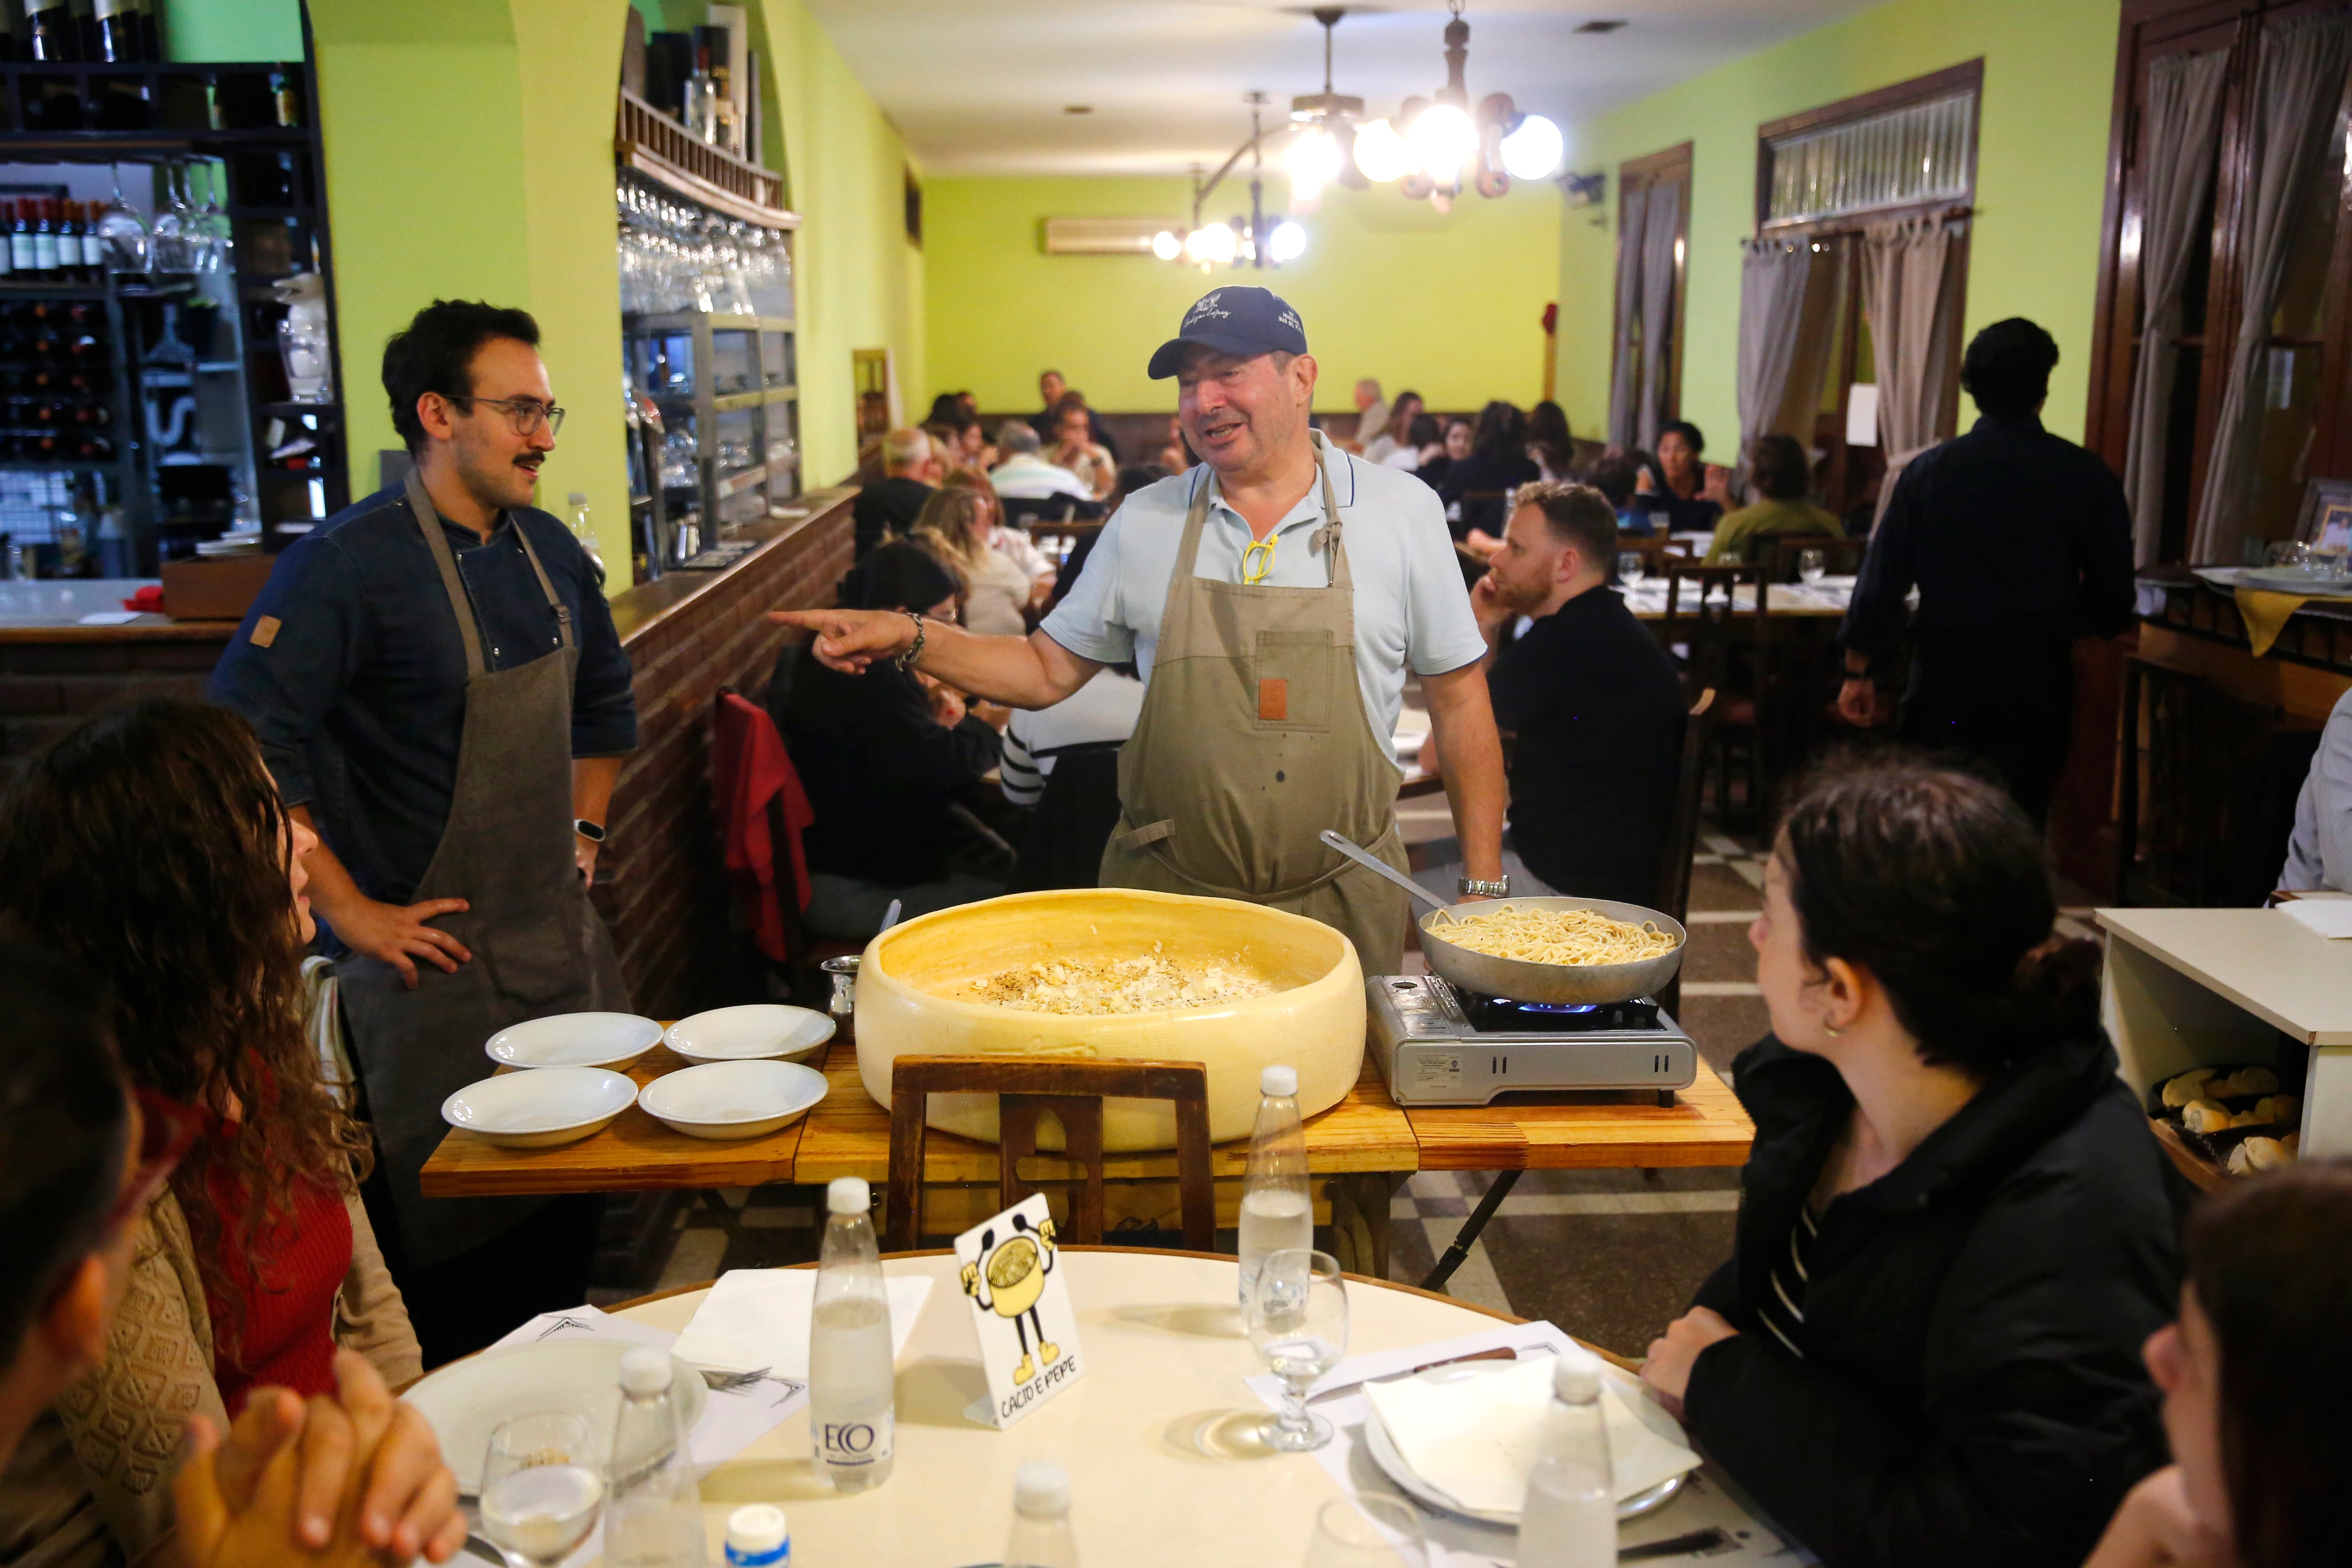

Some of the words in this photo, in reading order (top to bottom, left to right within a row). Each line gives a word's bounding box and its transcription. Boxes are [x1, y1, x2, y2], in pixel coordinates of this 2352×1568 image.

[1002, 1385, 1034, 1417] CACIO
[1035, 1377, 1043, 1394] E
[1045, 1355, 1076, 1388] PEPE
[825, 1423, 875, 1456] ECO
